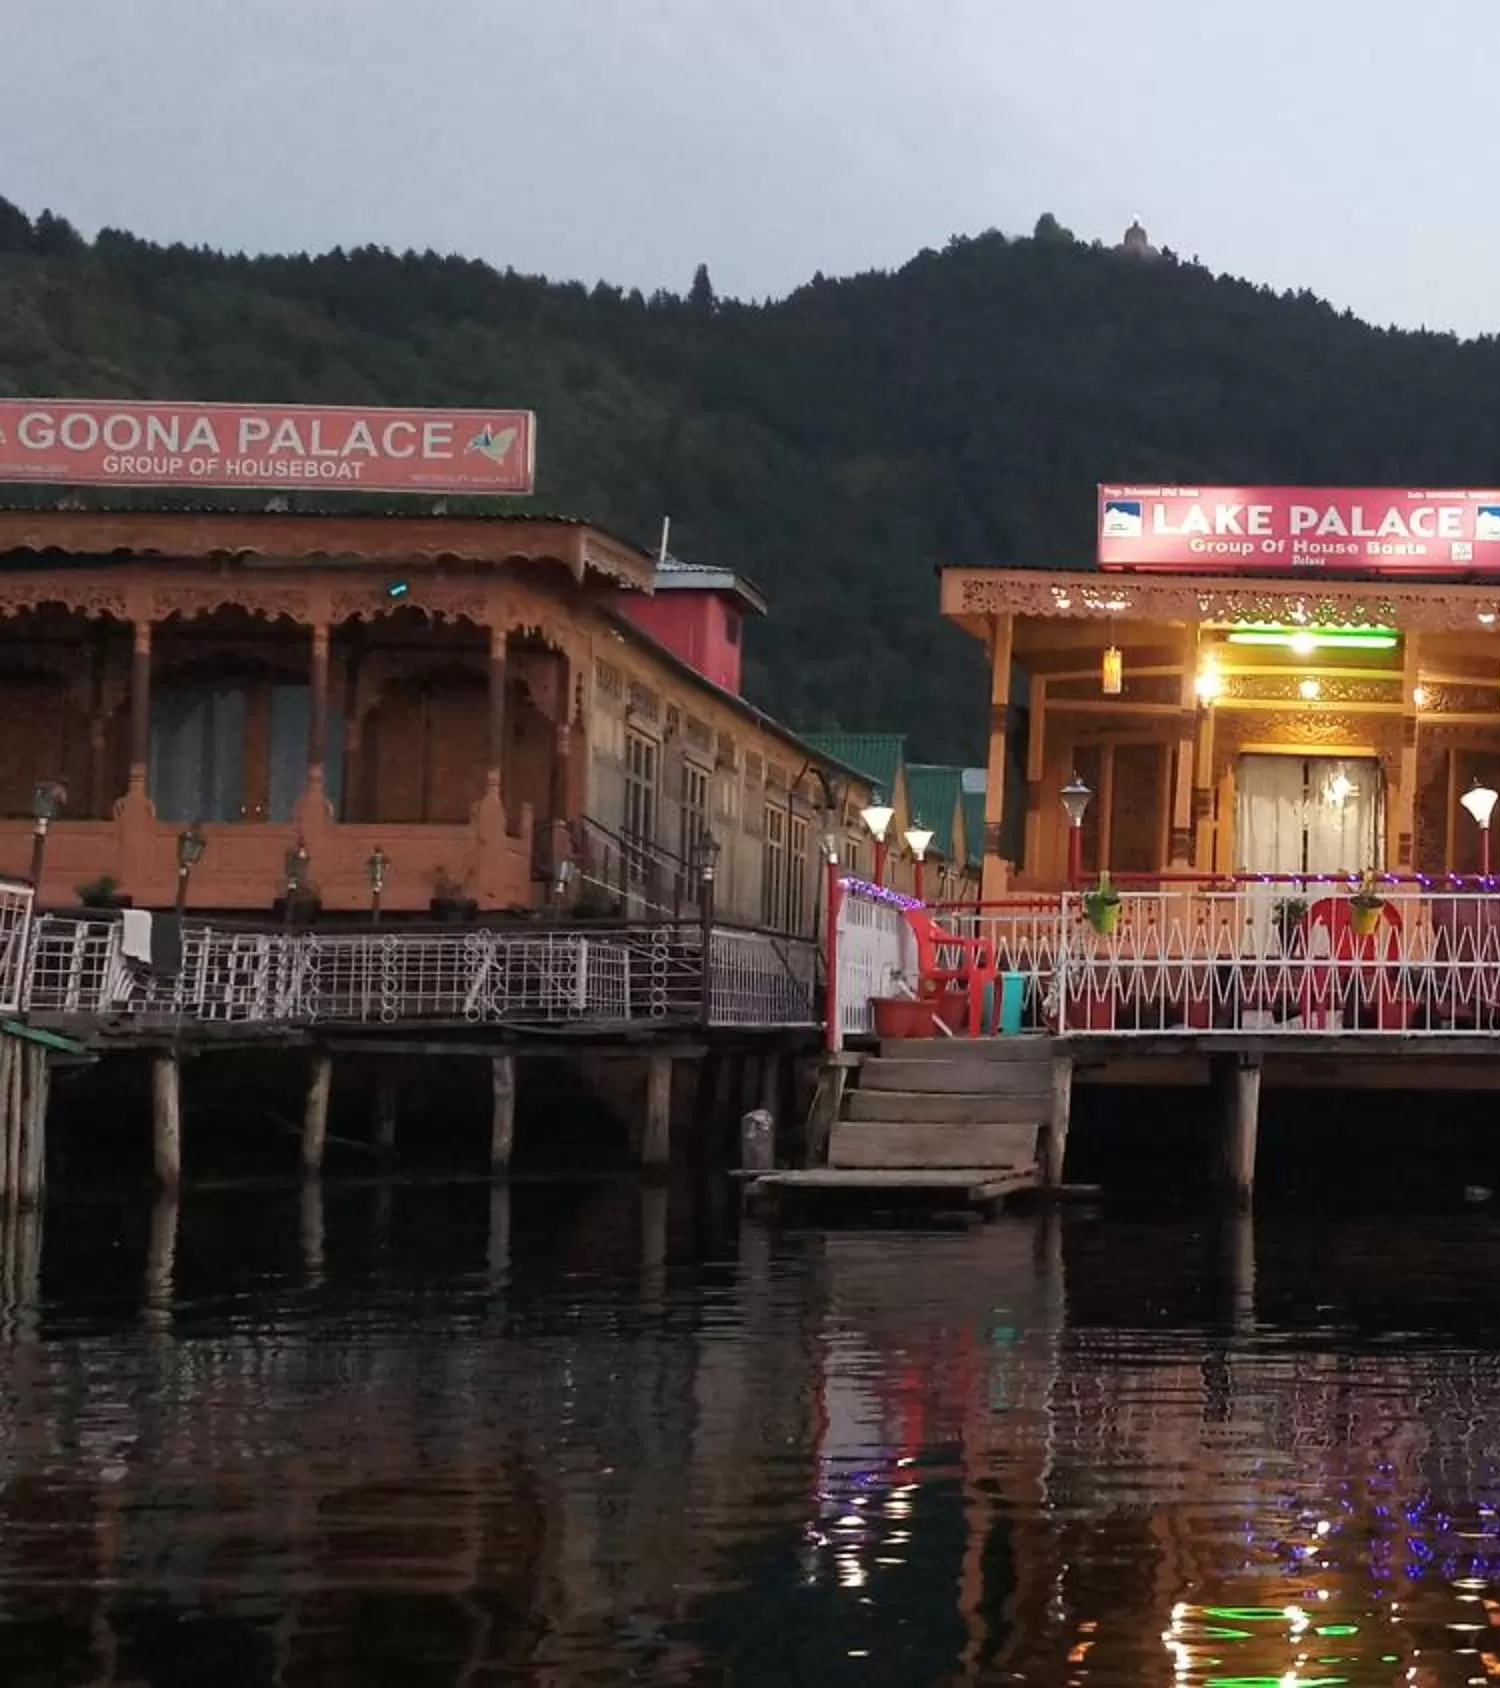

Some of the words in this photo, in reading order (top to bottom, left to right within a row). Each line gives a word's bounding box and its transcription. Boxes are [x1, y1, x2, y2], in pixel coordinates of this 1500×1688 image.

[17, 411, 221, 454] GOONA
[238, 417, 454, 460] PALACE
[103, 455, 183, 476] GROUP
[189, 458, 219, 477] OF
[226, 459, 365, 479] HOUSEBOAT
[1153, 503, 1273, 535] LAKE
[1290, 505, 1464, 538] PALACE
[1190, 538, 1255, 556] Group
[1261, 538, 1285, 553] Of
[1292, 540, 1360, 554] House
